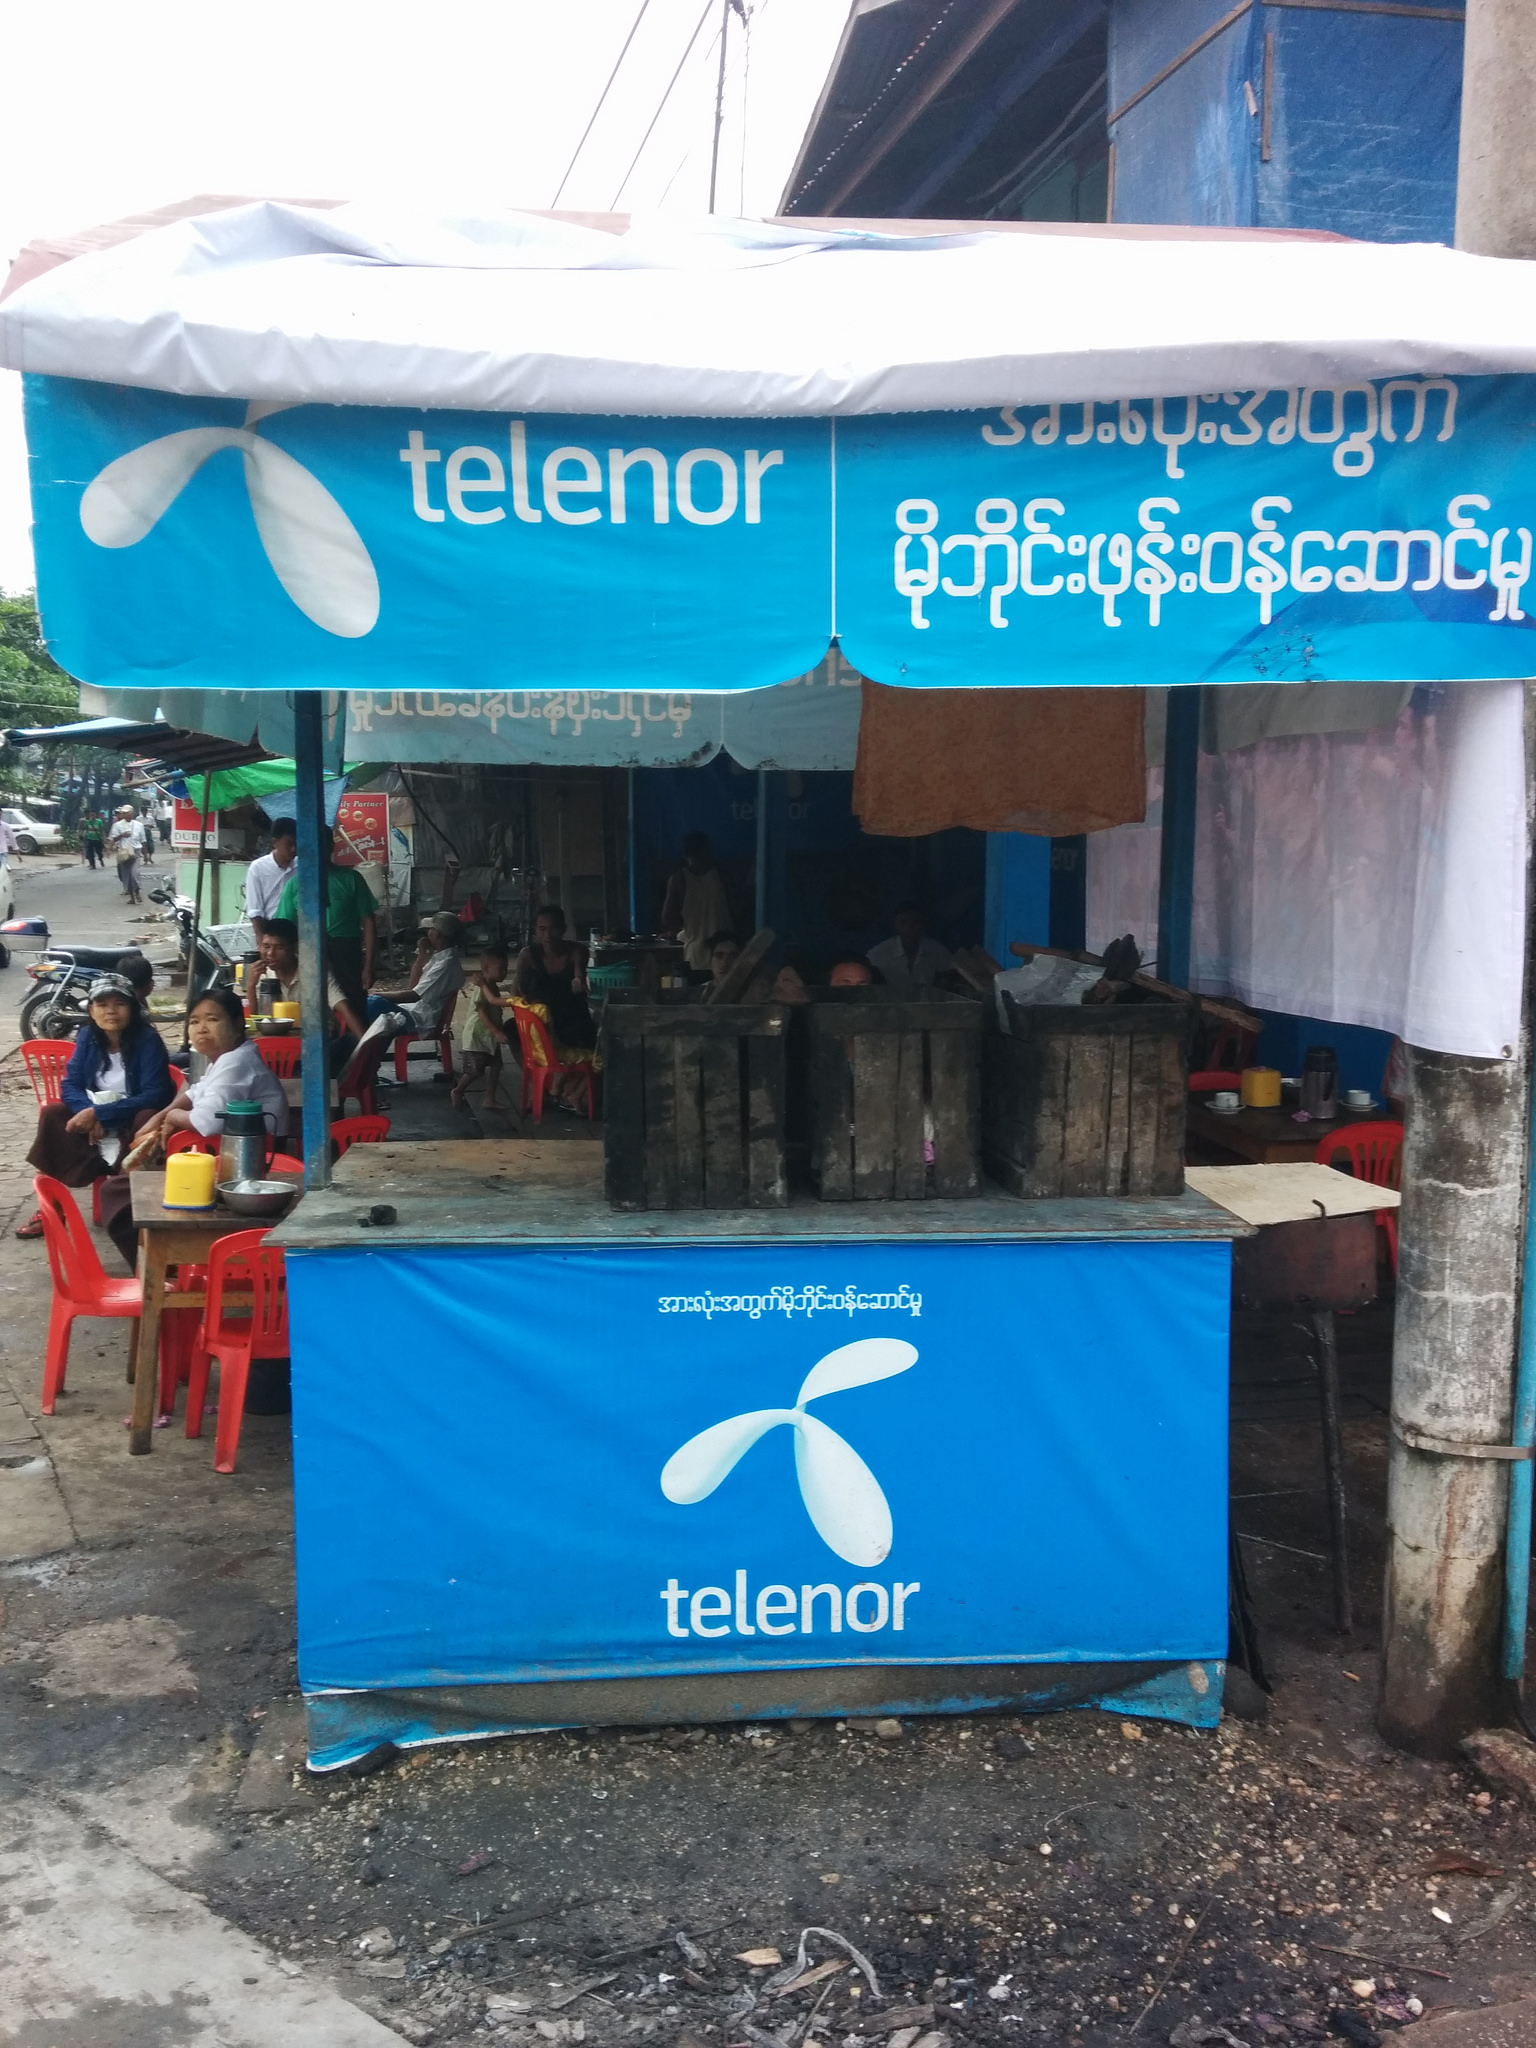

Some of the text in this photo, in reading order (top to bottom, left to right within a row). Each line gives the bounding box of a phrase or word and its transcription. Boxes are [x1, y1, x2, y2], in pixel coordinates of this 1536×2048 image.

[399, 421, 784, 526] telenor
[353, 800, 383, 808] Partner
[730, 796, 811, 821] telor
[174, 832, 216, 843] DUBO
[660, 1569, 921, 1638] telenor
